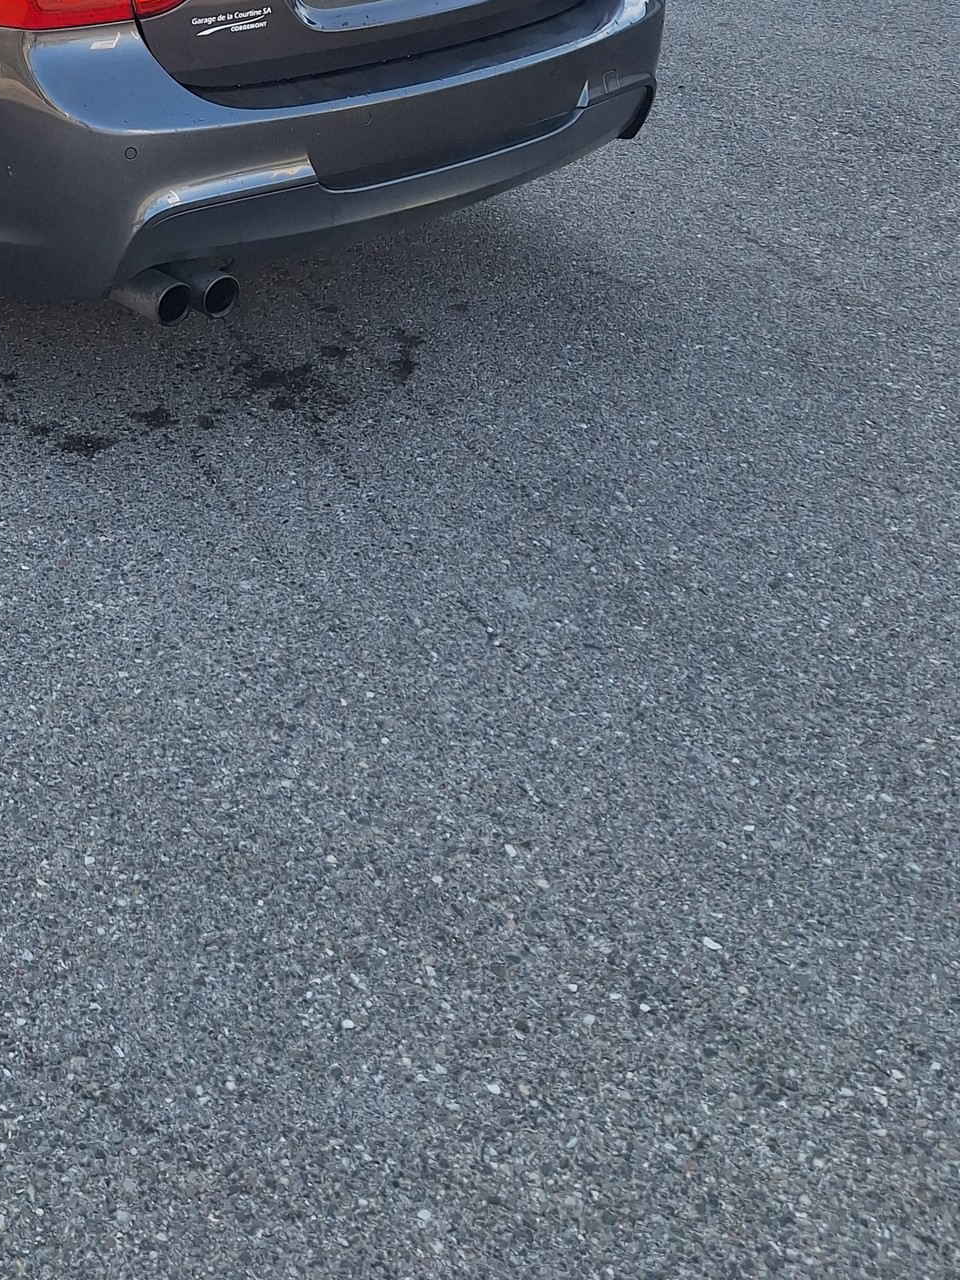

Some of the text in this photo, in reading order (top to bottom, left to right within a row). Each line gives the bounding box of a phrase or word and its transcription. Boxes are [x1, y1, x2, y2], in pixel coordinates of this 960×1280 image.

[191, 17, 216, 25] Garage
[217, 14, 226, 22] de
[234, 9, 262, 19] Courtine
[263, 7, 272, 15] SA
[230, 21, 268, 32] CORGEMONT
